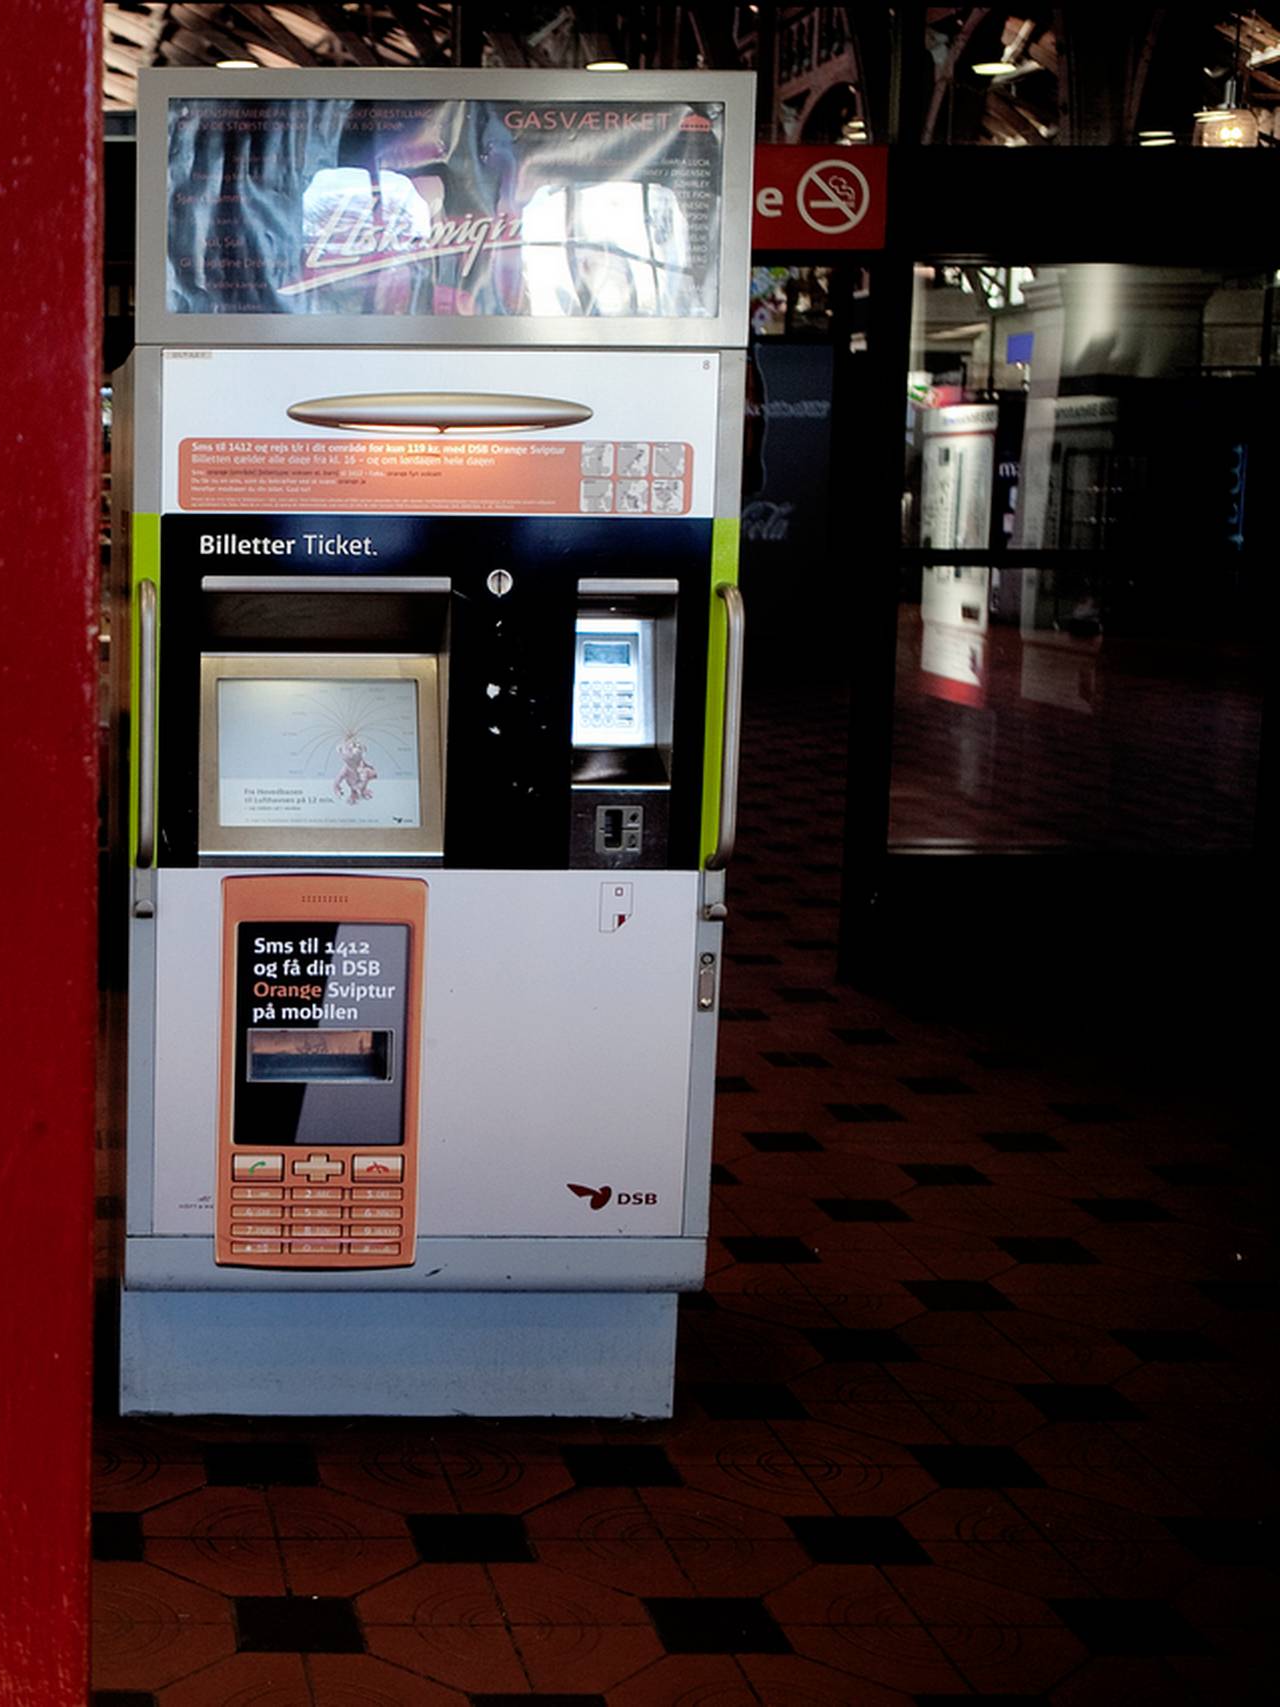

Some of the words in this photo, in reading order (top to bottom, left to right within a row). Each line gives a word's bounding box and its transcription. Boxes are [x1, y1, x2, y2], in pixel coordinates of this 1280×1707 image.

[504, 110, 672, 131] GASVÆRKET
[200, 534, 296, 555] Billetter
[303, 533, 378, 555] Ticket.
[253, 937, 293, 955] Sms
[299, 937, 319, 954] til
[324, 940, 370, 958] 1412
[253, 961, 277, 979] og
[283, 958, 301, 977] få
[306, 959, 336, 977] din
[341, 960, 381, 977] DSB
[253, 981, 323, 1001] Orange
[327, 981, 397, 1003] Sviptur
[253, 1002, 276, 1024] på
[281, 1002, 359, 1021] mobilen
[617, 1192, 658, 1205] DSB
